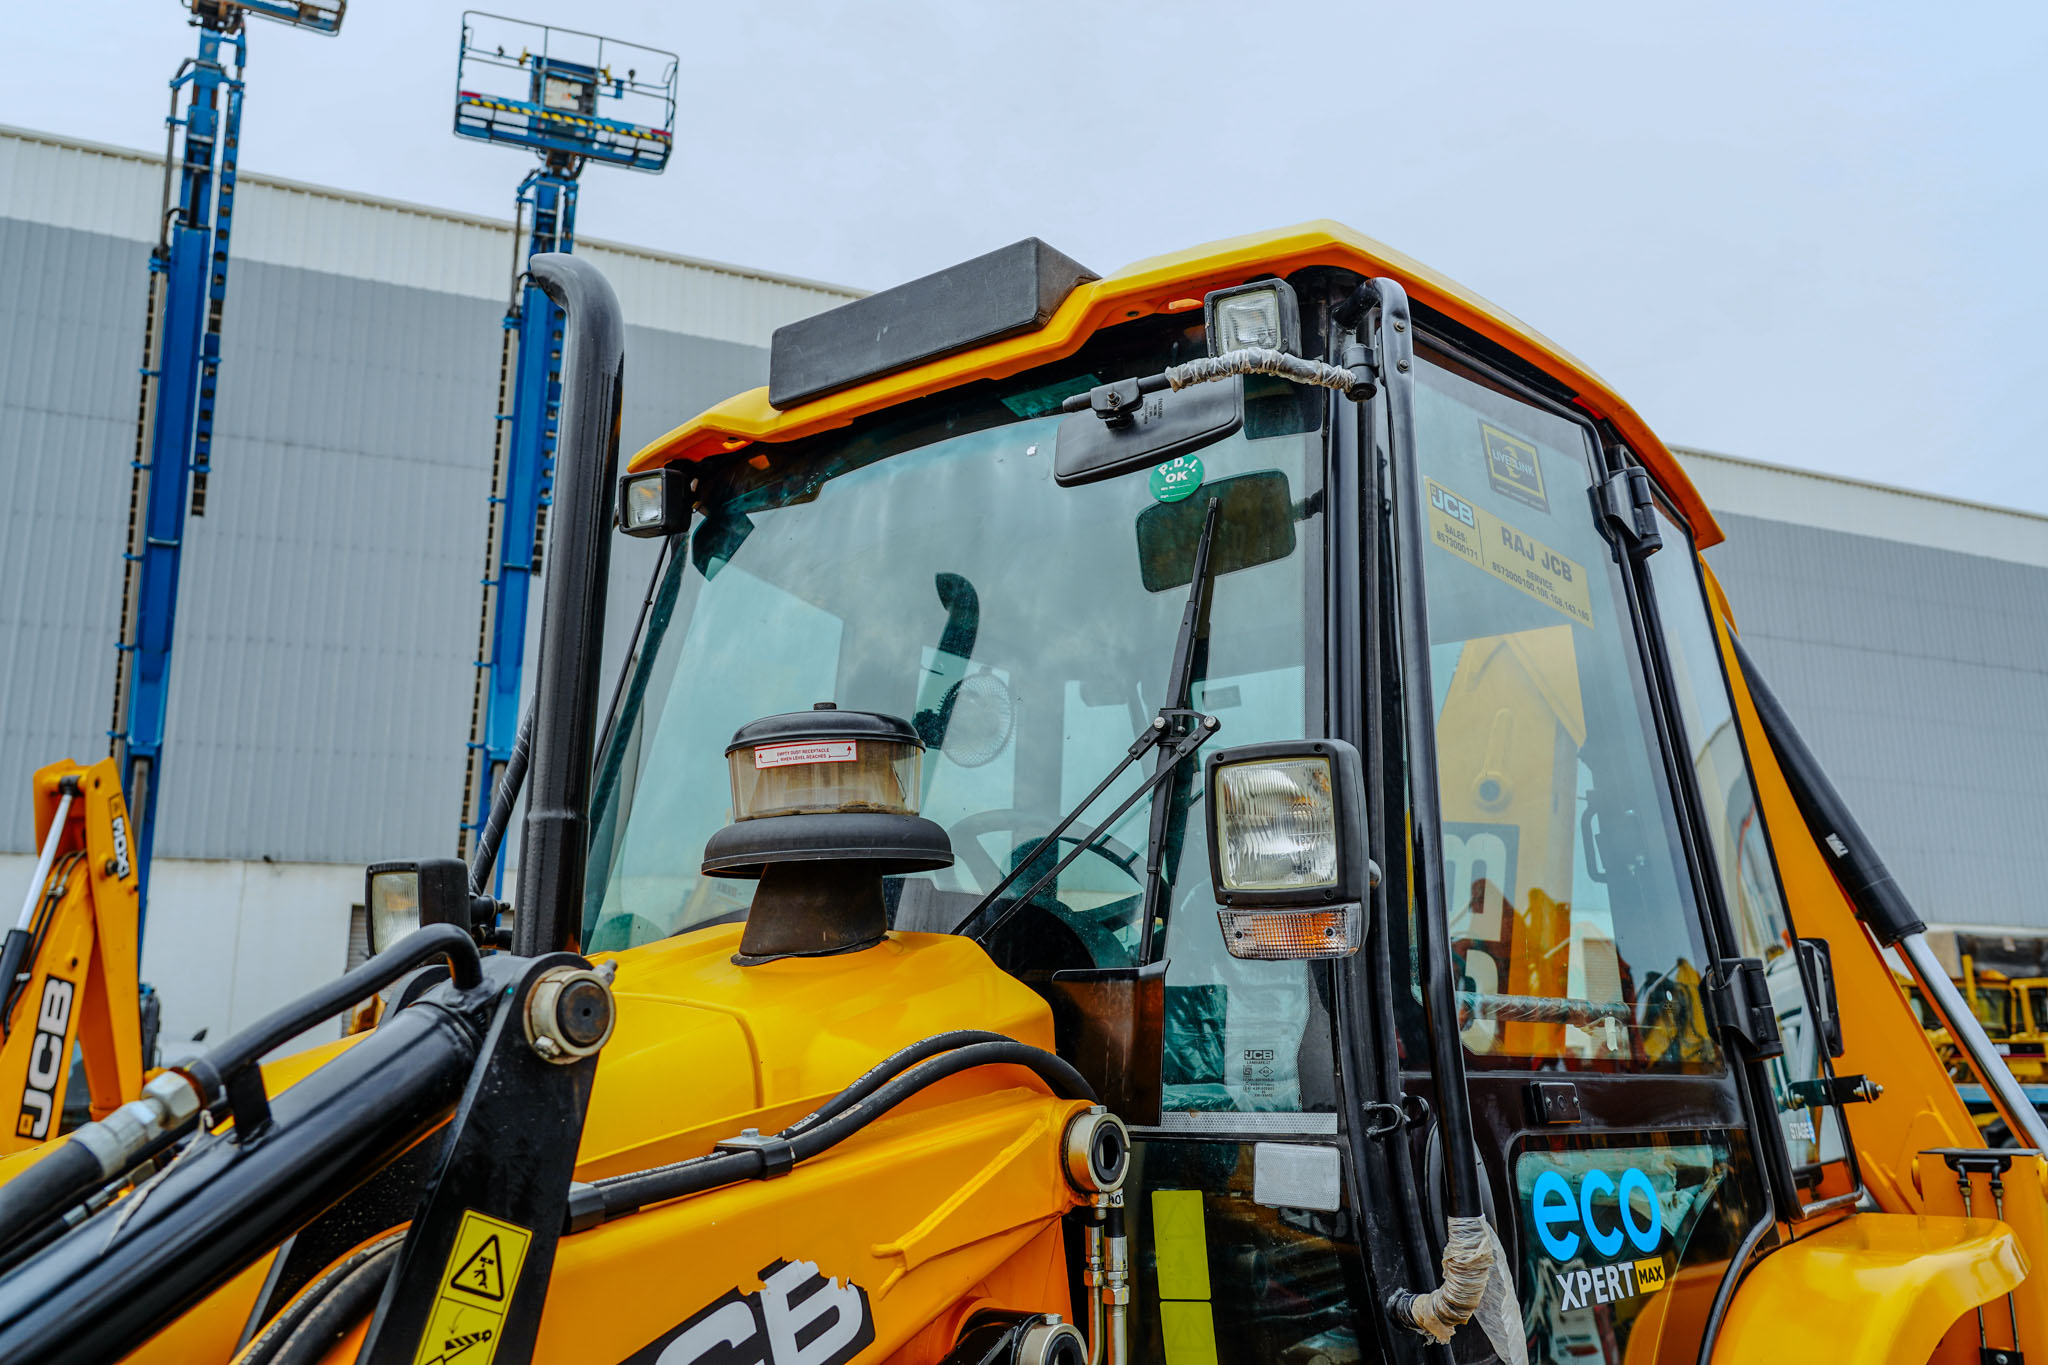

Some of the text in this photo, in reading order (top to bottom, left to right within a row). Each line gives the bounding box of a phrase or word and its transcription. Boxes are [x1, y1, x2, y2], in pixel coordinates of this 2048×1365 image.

[1165, 470, 1188, 483] OK
[1431, 487, 1474, 527] JCB
[1501, 526, 1573, 583] RAJ JCB
[24, 978, 73, 1138] JCB
[1245, 1051, 1273, 1059] JCB
[1533, 1168, 1662, 1262] eco
[1556, 1262, 1664, 1311] XPERT MAX
